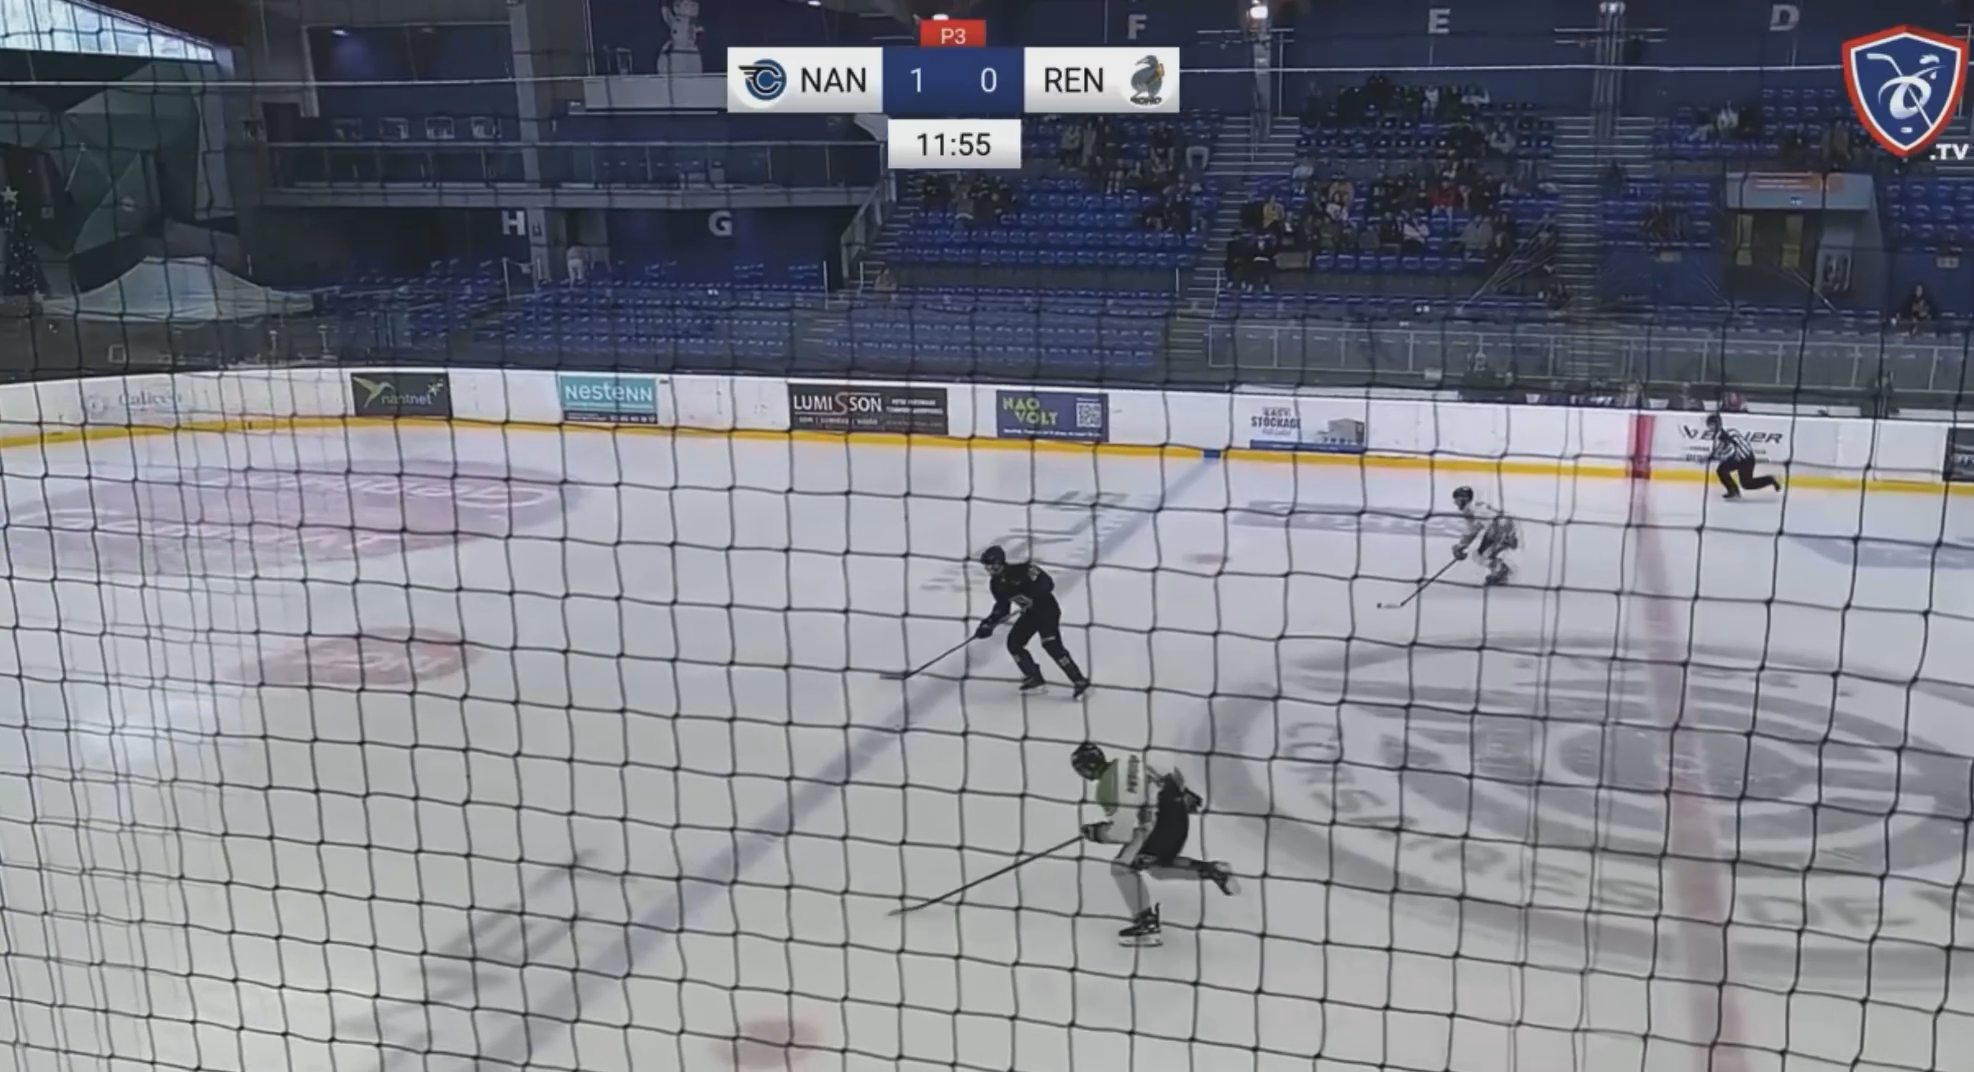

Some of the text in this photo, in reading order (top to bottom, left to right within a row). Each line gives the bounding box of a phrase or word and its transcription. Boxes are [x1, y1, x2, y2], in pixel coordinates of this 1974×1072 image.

[1128, 14, 1146, 40] F
[1427, 8, 1450, 34] E
[1770, 4, 1799, 31] D
[502, 210, 526, 235] H
[708, 210, 732, 236] G
[1014, 411, 1058, 425] VOLT
